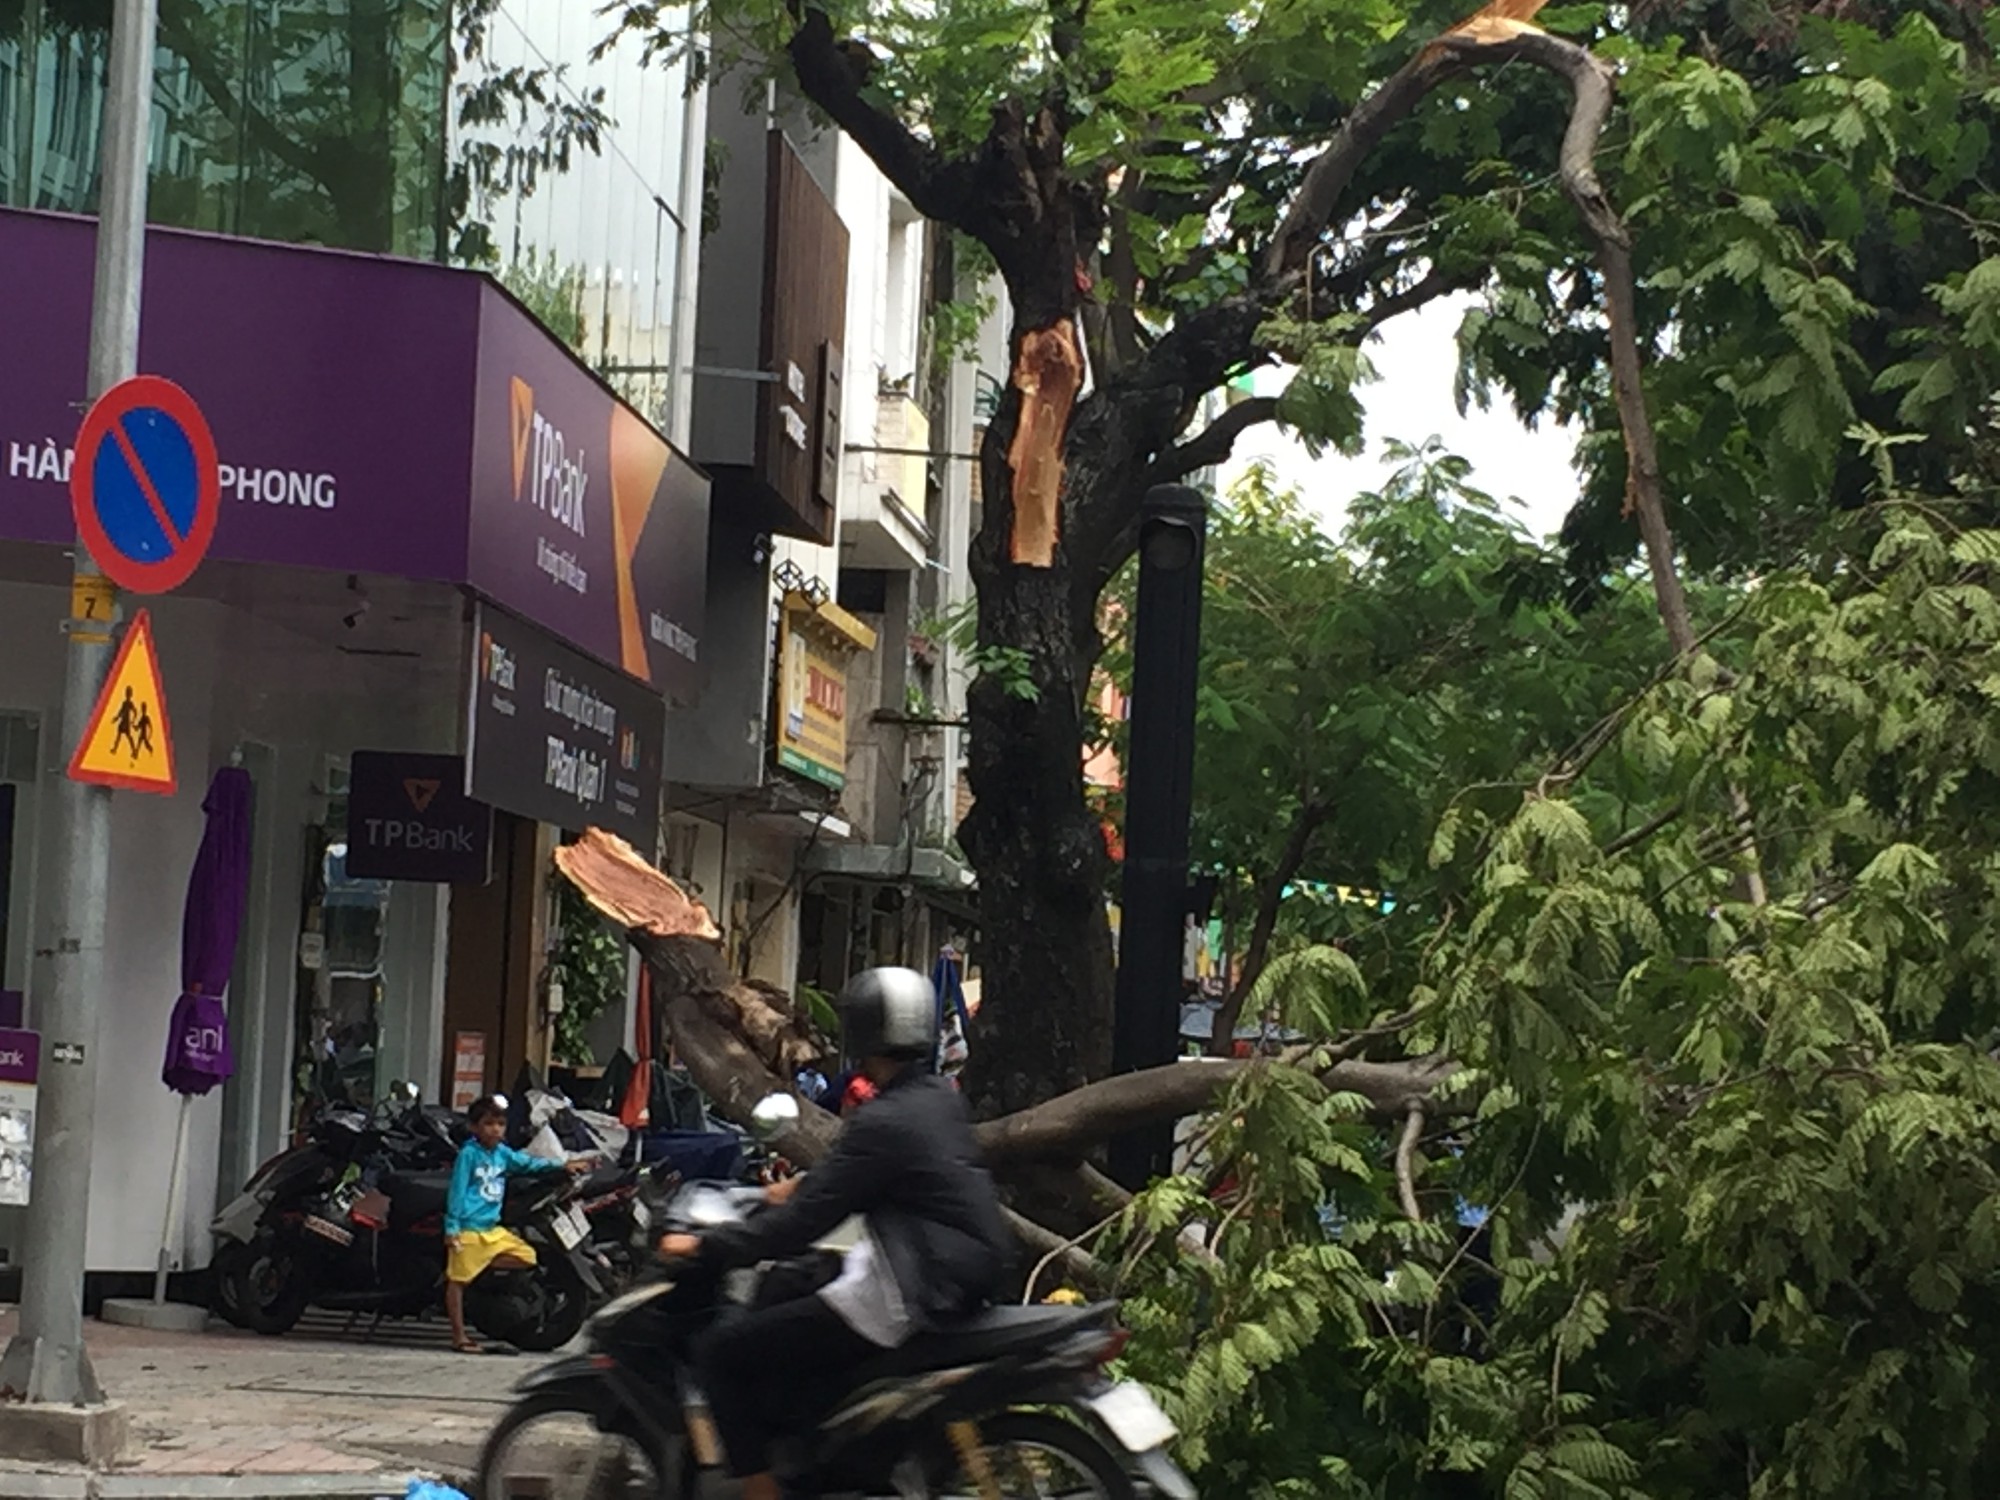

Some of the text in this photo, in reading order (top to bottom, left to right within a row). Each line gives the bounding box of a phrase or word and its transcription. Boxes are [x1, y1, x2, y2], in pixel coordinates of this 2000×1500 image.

[217, 464, 336, 508] PHONG
[531, 409, 588, 538] TPBank
[84, 597, 96, 619] 7
[365, 818, 473, 851] TPBank
